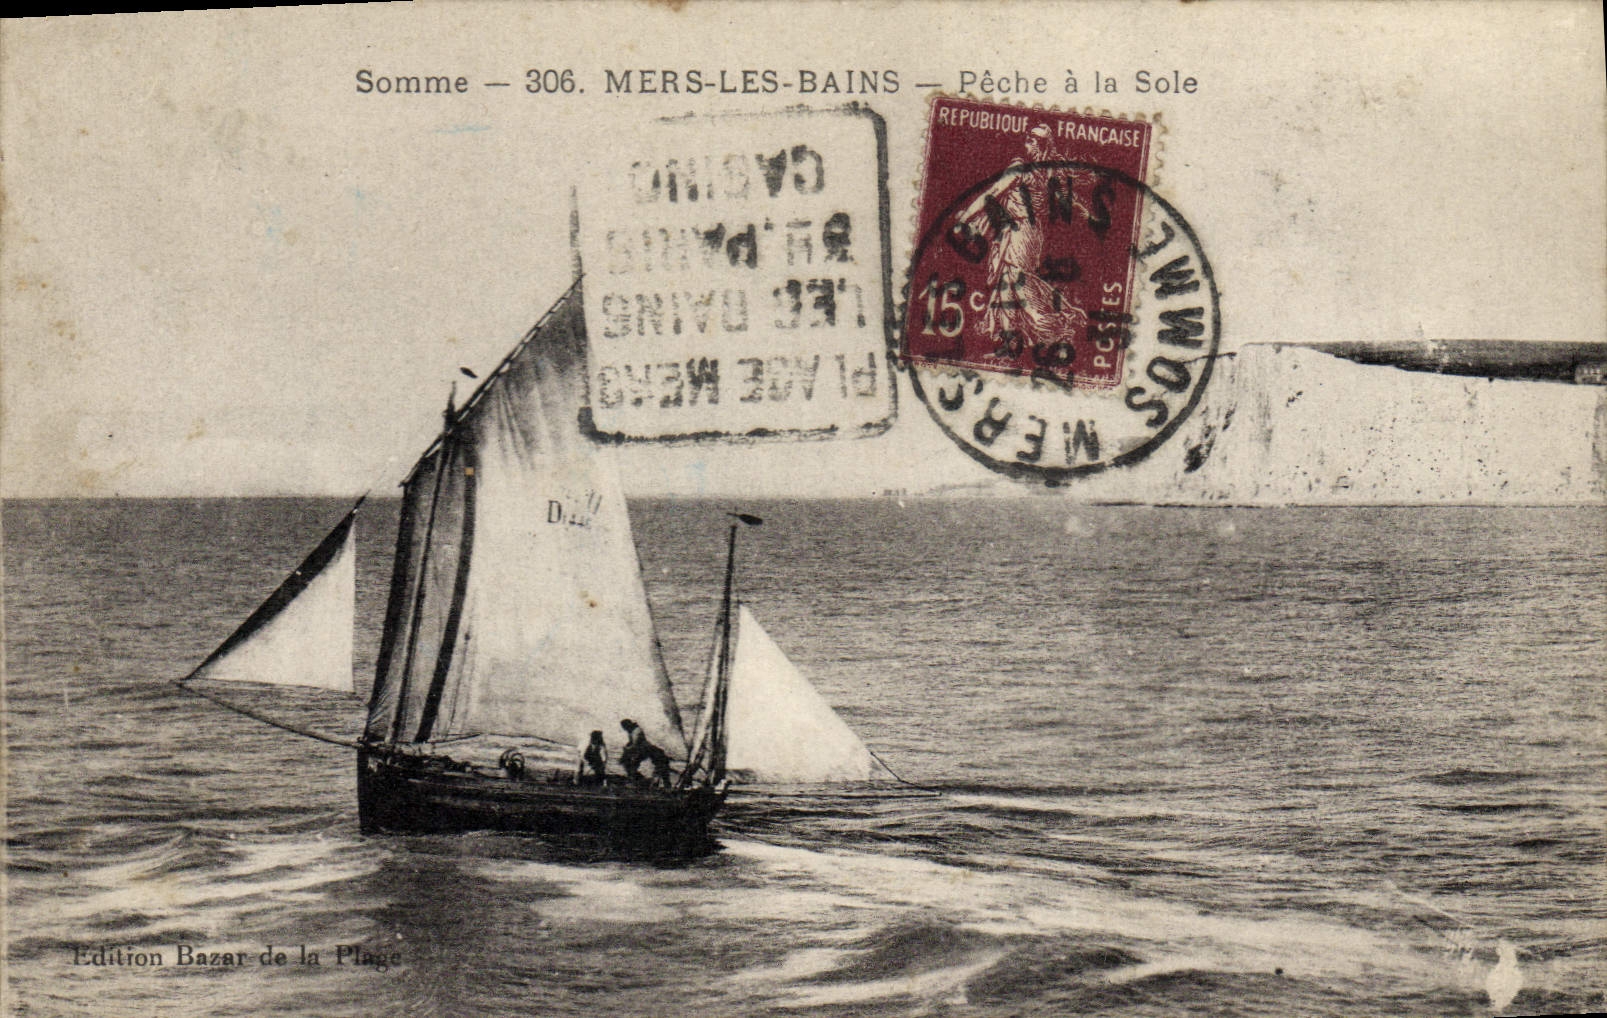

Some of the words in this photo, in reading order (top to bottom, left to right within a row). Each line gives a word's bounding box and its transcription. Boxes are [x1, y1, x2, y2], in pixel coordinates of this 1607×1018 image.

[939, 106, 1028, 133] REPUBLIQUE
[1057, 120, 1140, 148] FRANÇAISE
[918, 280, 964, 337] 15
[1125, 221, 1205, 428] SOMME
